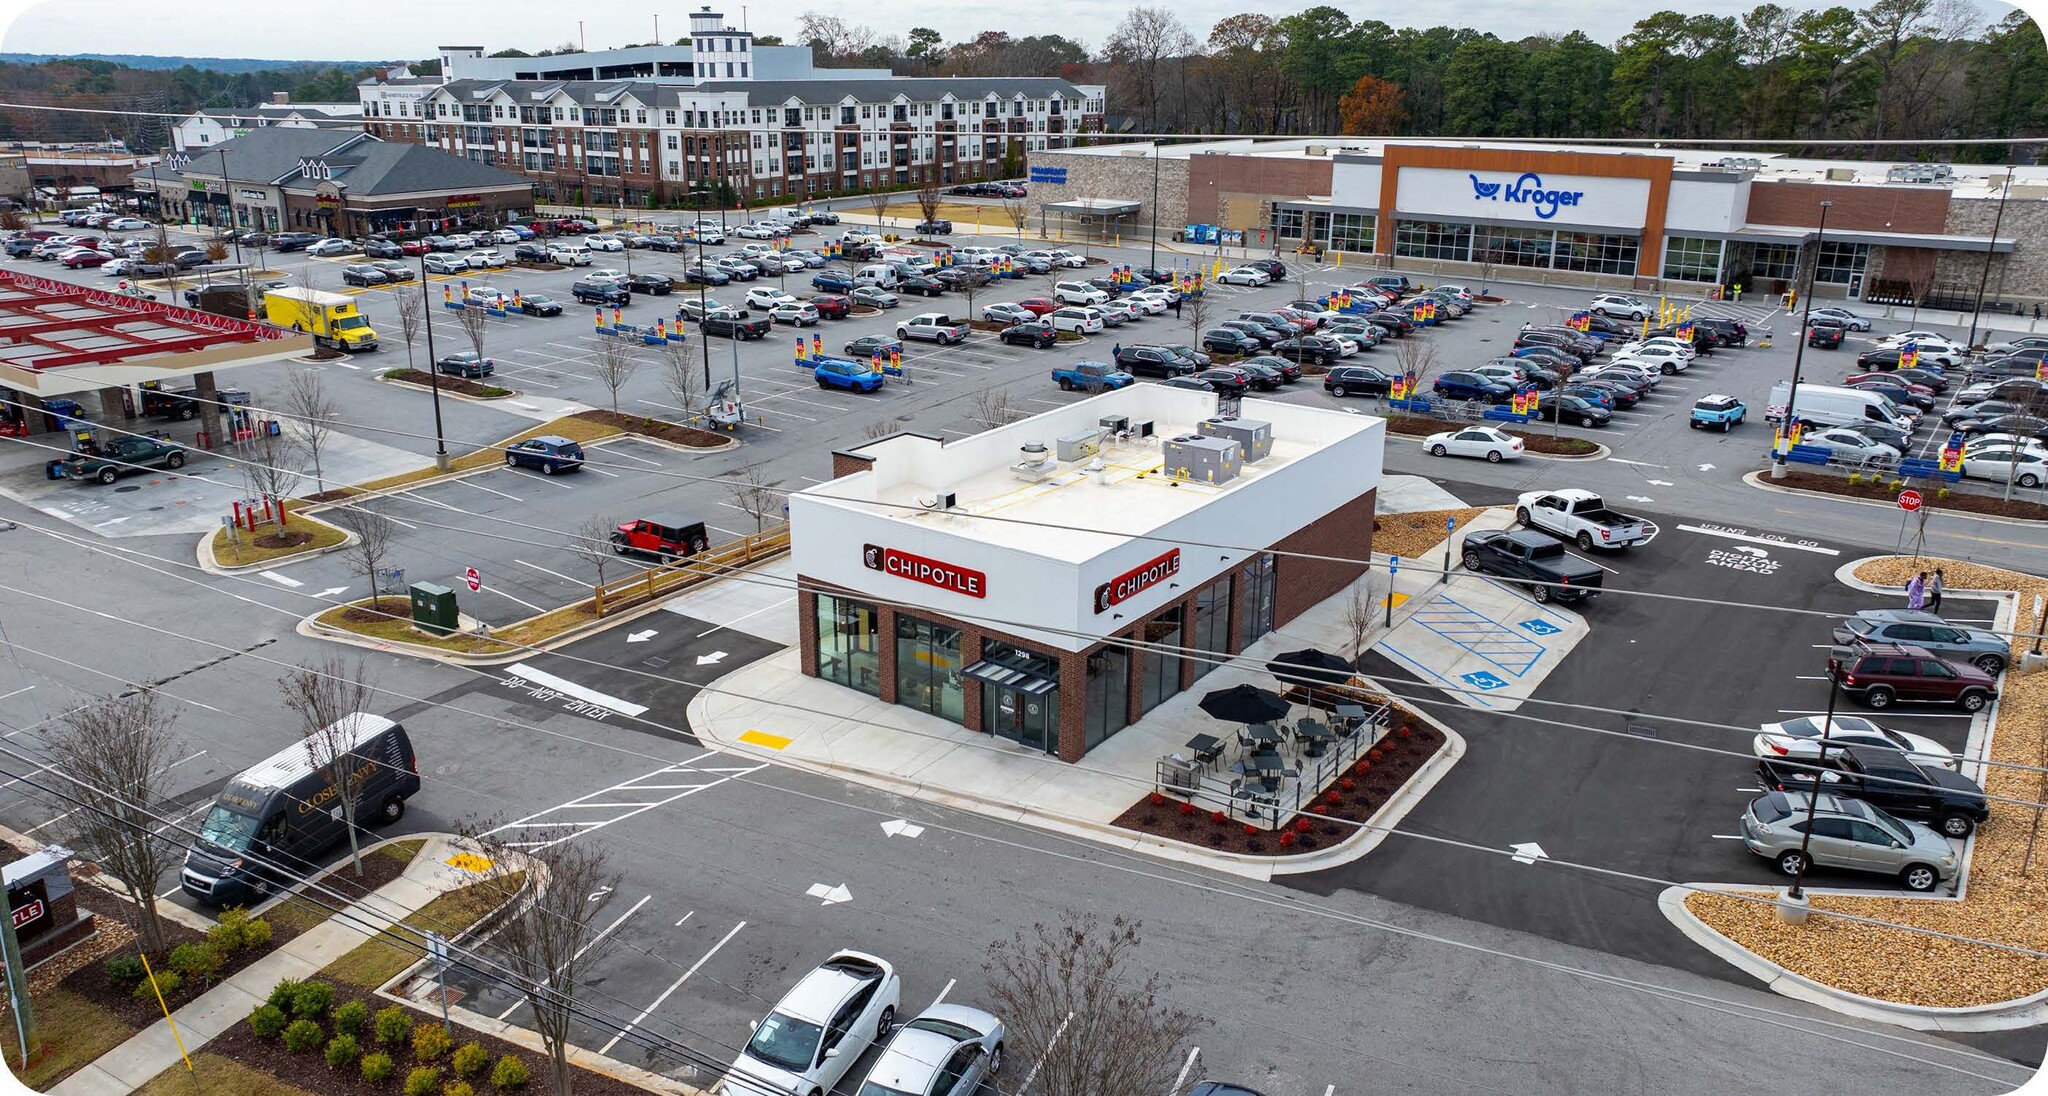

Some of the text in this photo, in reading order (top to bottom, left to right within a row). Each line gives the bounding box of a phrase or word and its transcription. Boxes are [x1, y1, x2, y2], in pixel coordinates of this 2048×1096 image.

[1504, 173, 1584, 219] Kroger
[1900, 495, 1920, 506] STOP
[1699, 523, 1819, 548] DO NOT ENTER
[1704, 559, 1774, 575] AHEAD
[1708, 554, 1778, 569] PICKUP
[1710, 549, 1782, 567] DIGITAL
[887, 556, 979, 593] CHIPOTLE
[1117, 555, 1180, 599] CHIPOTLE
[1015, 649, 1030, 660] 1298
[500, 675, 614, 721] DO NOT ENTER
[298, 779, 342, 814] CLOSE
